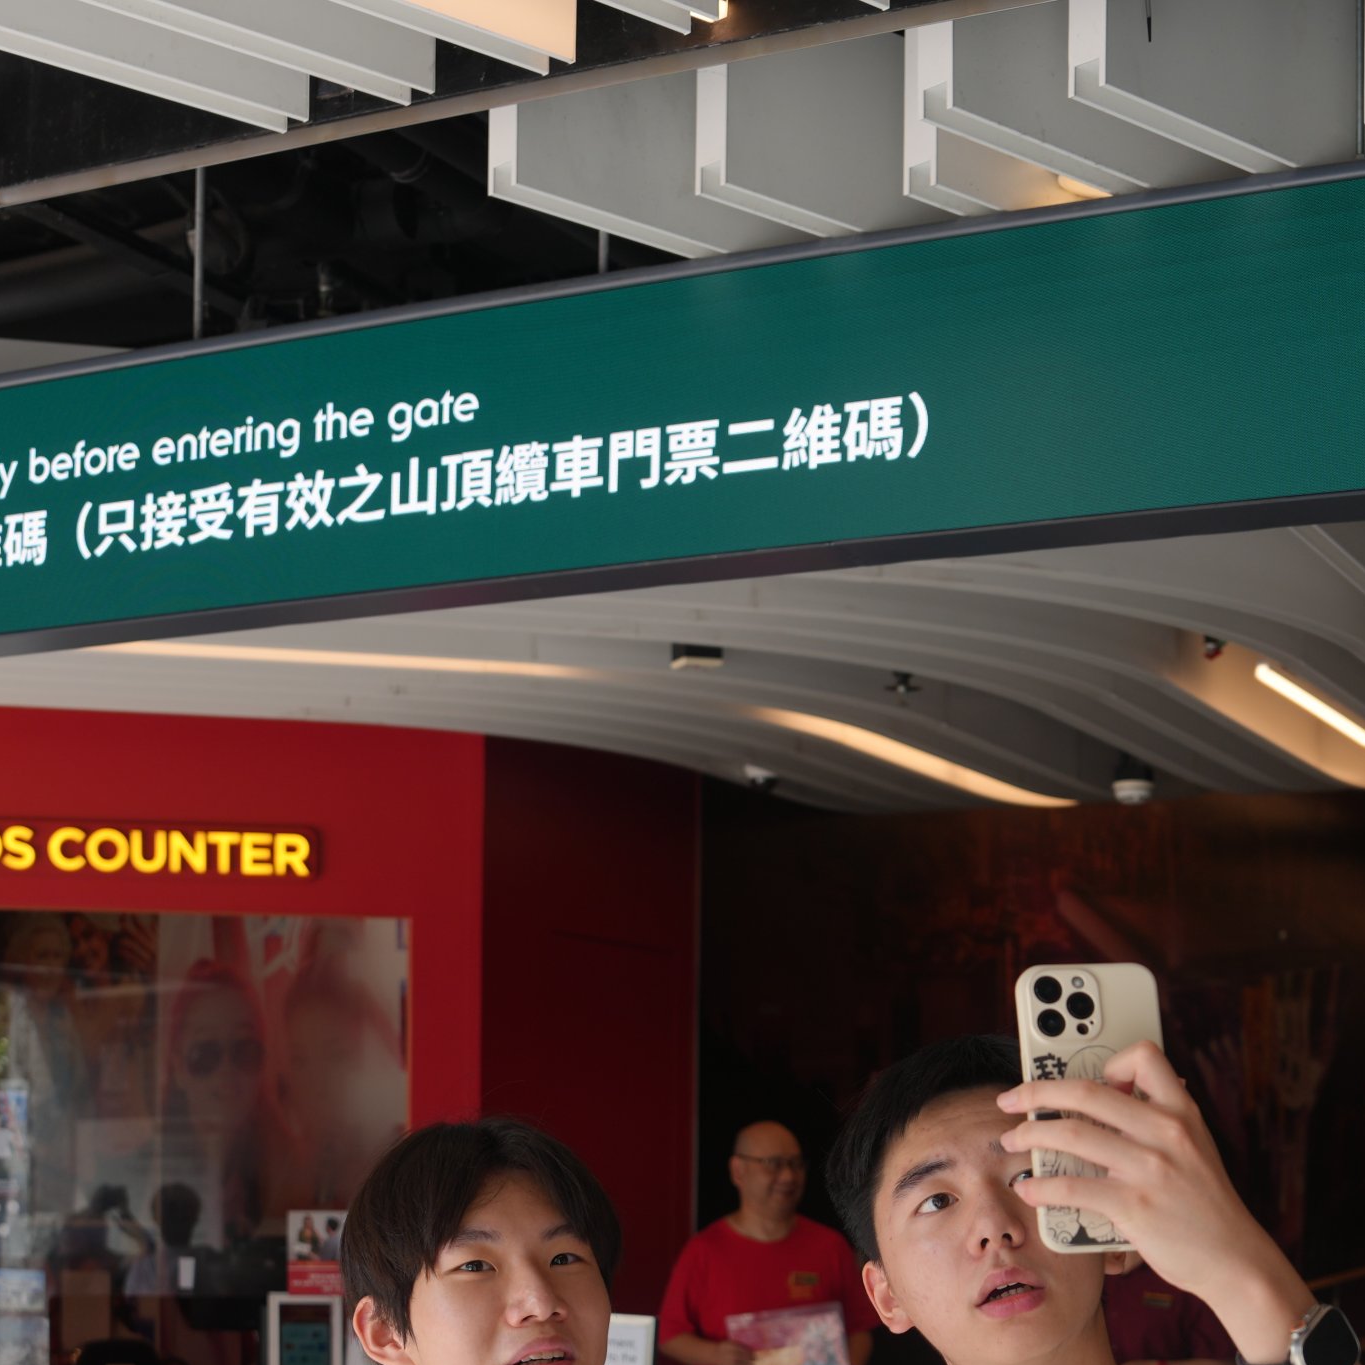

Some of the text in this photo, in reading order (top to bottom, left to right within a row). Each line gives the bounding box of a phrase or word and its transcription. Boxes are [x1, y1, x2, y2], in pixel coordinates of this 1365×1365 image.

[28, 440, 141, 484] before
[151, 416, 302, 466] entering
[313, 402, 374, 443] the
[387, 390, 481, 443] gate
[47, 826, 311, 877] COUNTER
